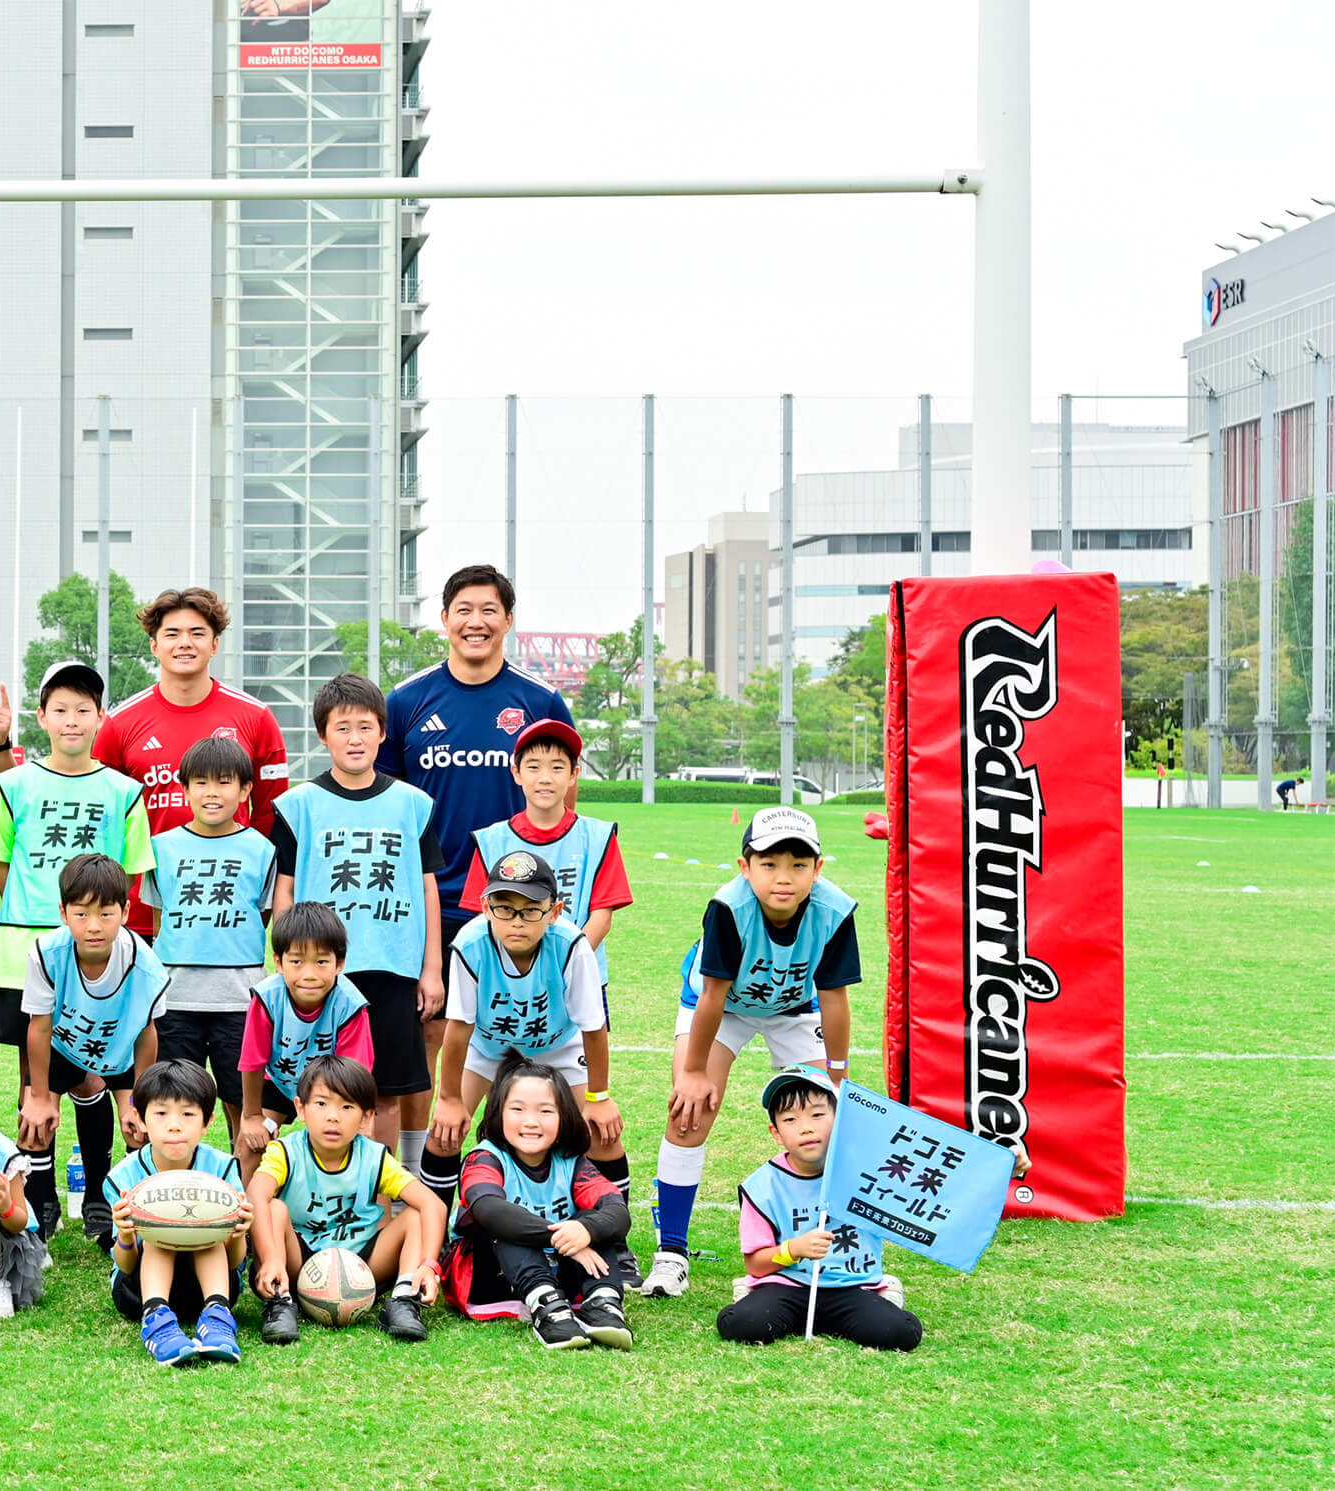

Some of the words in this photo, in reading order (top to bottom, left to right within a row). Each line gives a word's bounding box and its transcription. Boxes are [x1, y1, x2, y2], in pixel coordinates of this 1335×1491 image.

[271, 47, 292, 55] NTT
[342, 56, 378, 64] OSAKA
[1222, 279, 1245, 310] ESR
[40, 800, 105, 821] ドコモ
[42, 823, 97, 849] 未来
[325, 831, 402, 857] ドコモ
[177, 859, 242, 878] ドコモ
[330, 860, 396, 893] 未来
[178, 881, 235, 905] 未来
[960, 605, 1059, 1178] RedHurricane
[169, 910, 247, 928] フィールド
[749, 958, 809, 985] ドコモ
[490, 990, 548, 1017] ドコモ
[740, 982, 803, 1004] 未来
[61, 1004, 119, 1037] ドコモ
[489, 1015, 547, 1038] 未来
[53, 1025, 108, 1058] 未来
[848, 1092, 888, 1115] docomo
[890, 1124, 966, 1170] ドコモ
[878, 1154, 948, 1196] 未来
[144, 1188, 232, 1207] GILBERT
[859, 1172, 951, 1223] フィールド
[850, 1200, 932, 1243] ドコモ未来プロジェクト
